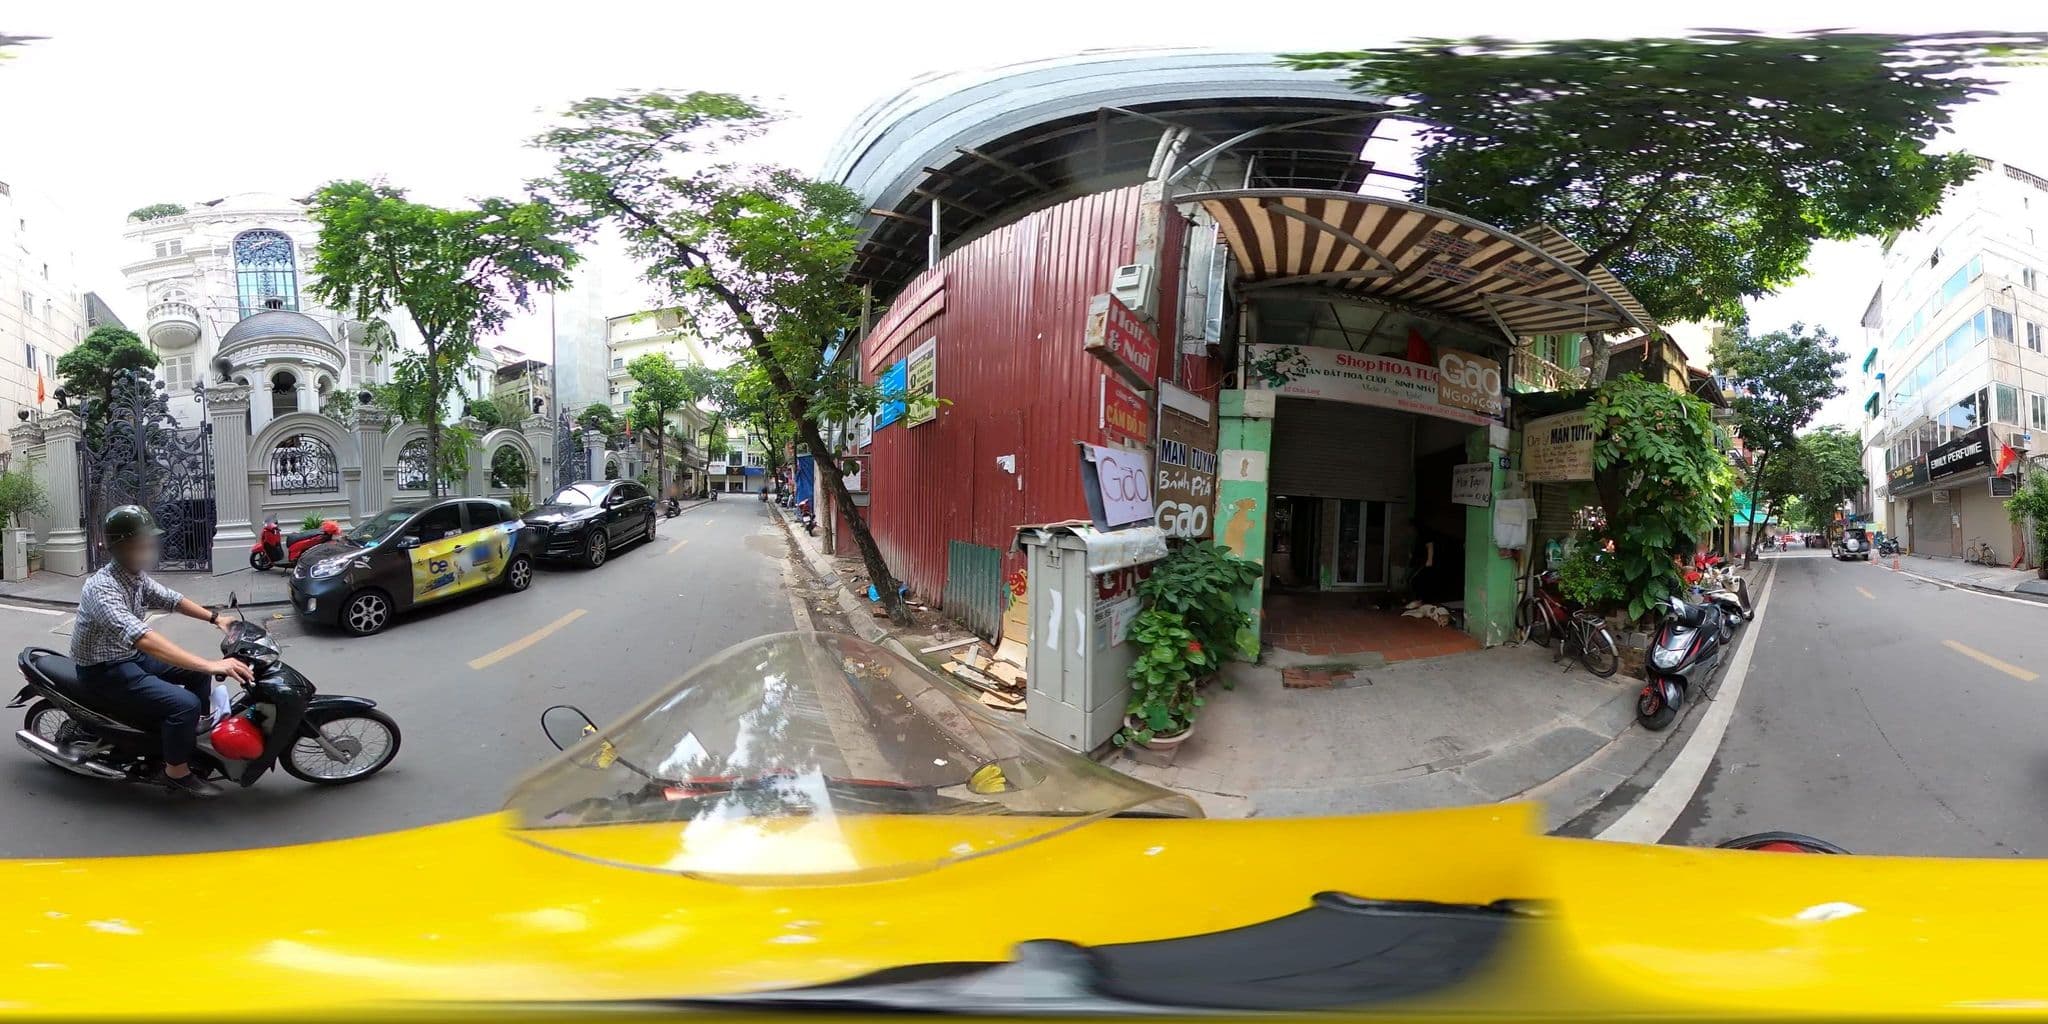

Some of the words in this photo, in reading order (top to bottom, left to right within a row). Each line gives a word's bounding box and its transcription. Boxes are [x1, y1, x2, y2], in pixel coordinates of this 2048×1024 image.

[1122, 339, 1151, 371] Nail
[1336, 353, 1376, 372] Shop
[1379, 361, 1412, 378] HOA
[1948, 441, 1982, 463] PERFUME
[429, 558, 449, 575] be
